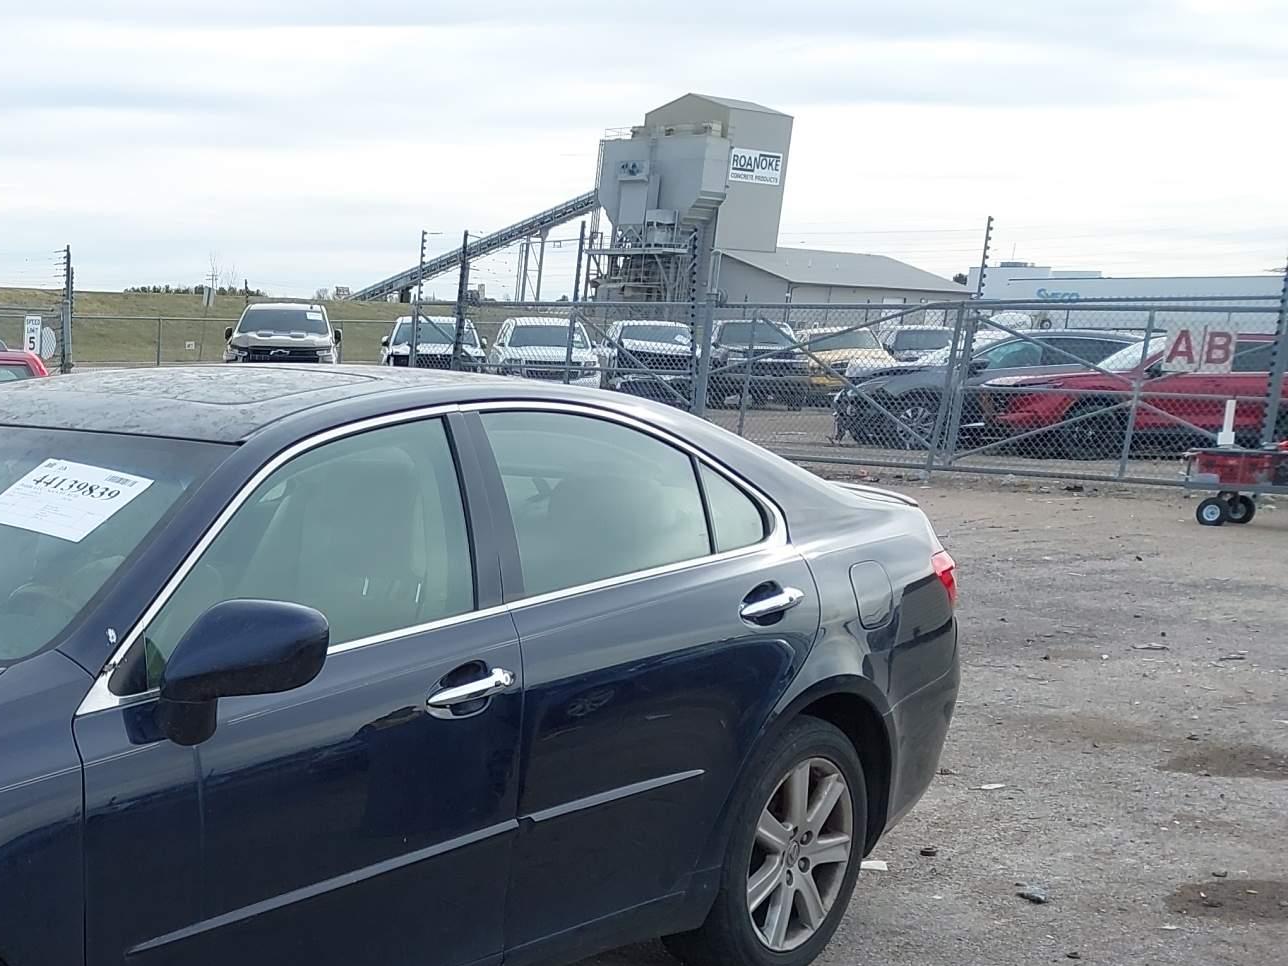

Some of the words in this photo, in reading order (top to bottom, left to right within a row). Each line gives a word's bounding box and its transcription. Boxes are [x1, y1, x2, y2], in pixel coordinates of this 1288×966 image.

[732, 153, 781, 172] ROANOKE
[755, 174, 778, 184] PRODUCTS
[28, 336, 35, 350] 5
[33, 474, 121, 500] 44139839
